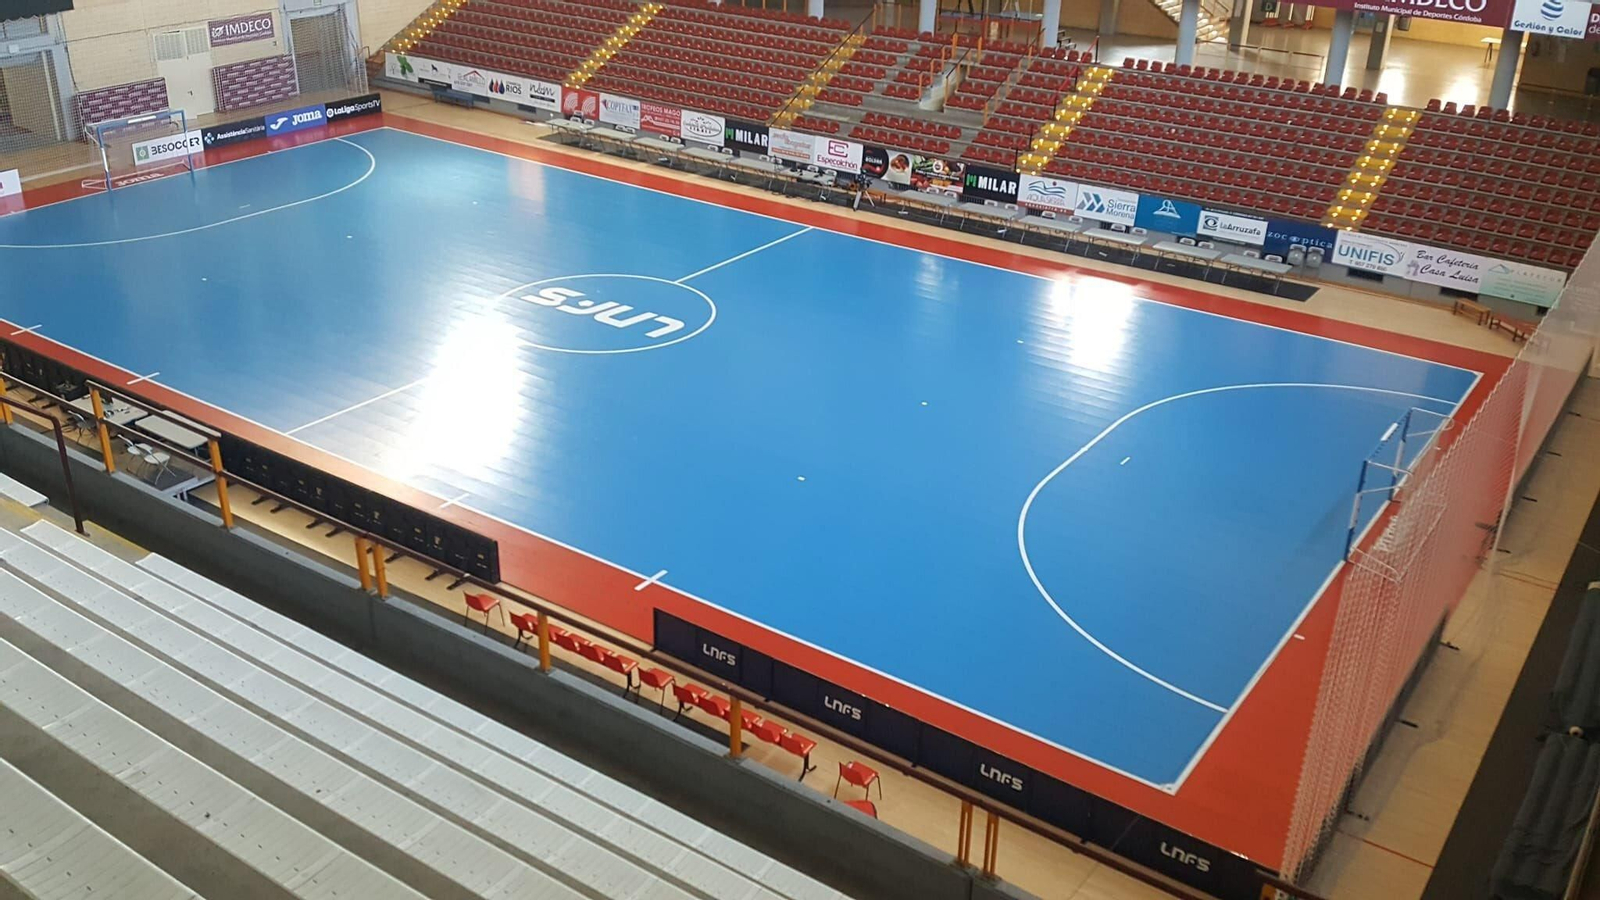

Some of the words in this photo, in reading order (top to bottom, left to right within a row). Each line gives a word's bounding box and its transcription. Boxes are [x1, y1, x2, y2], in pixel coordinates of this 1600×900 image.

[1353, 2, 1381, 12] Instituto
[1381, 6, 1412, 16] Municipal
[1423, 10, 1454, 20] Deportes
[225, 18, 272, 35] IMDECO
[1557, 26, 1583, 36] Calor
[735, 128, 769, 148] MILAR
[977, 175, 1017, 195] MILAR
[1105, 208, 1134, 220] Morena
[1107, 199, 1136, 213] Sierra
[1338, 244, 1395, 266] UNIFIS
[1416, 250, 1433, 261] Bar
[1420, 264, 1446, 277] Casa
[1449, 270, 1479, 284] Luisa
[520, 287, 685, 338] LNFS
[703, 643, 736, 666] LNFS
[824, 695, 862, 720] LNFS
[980, 763, 1024, 791] LNFS
[1160, 841, 1210, 873] LNFS
